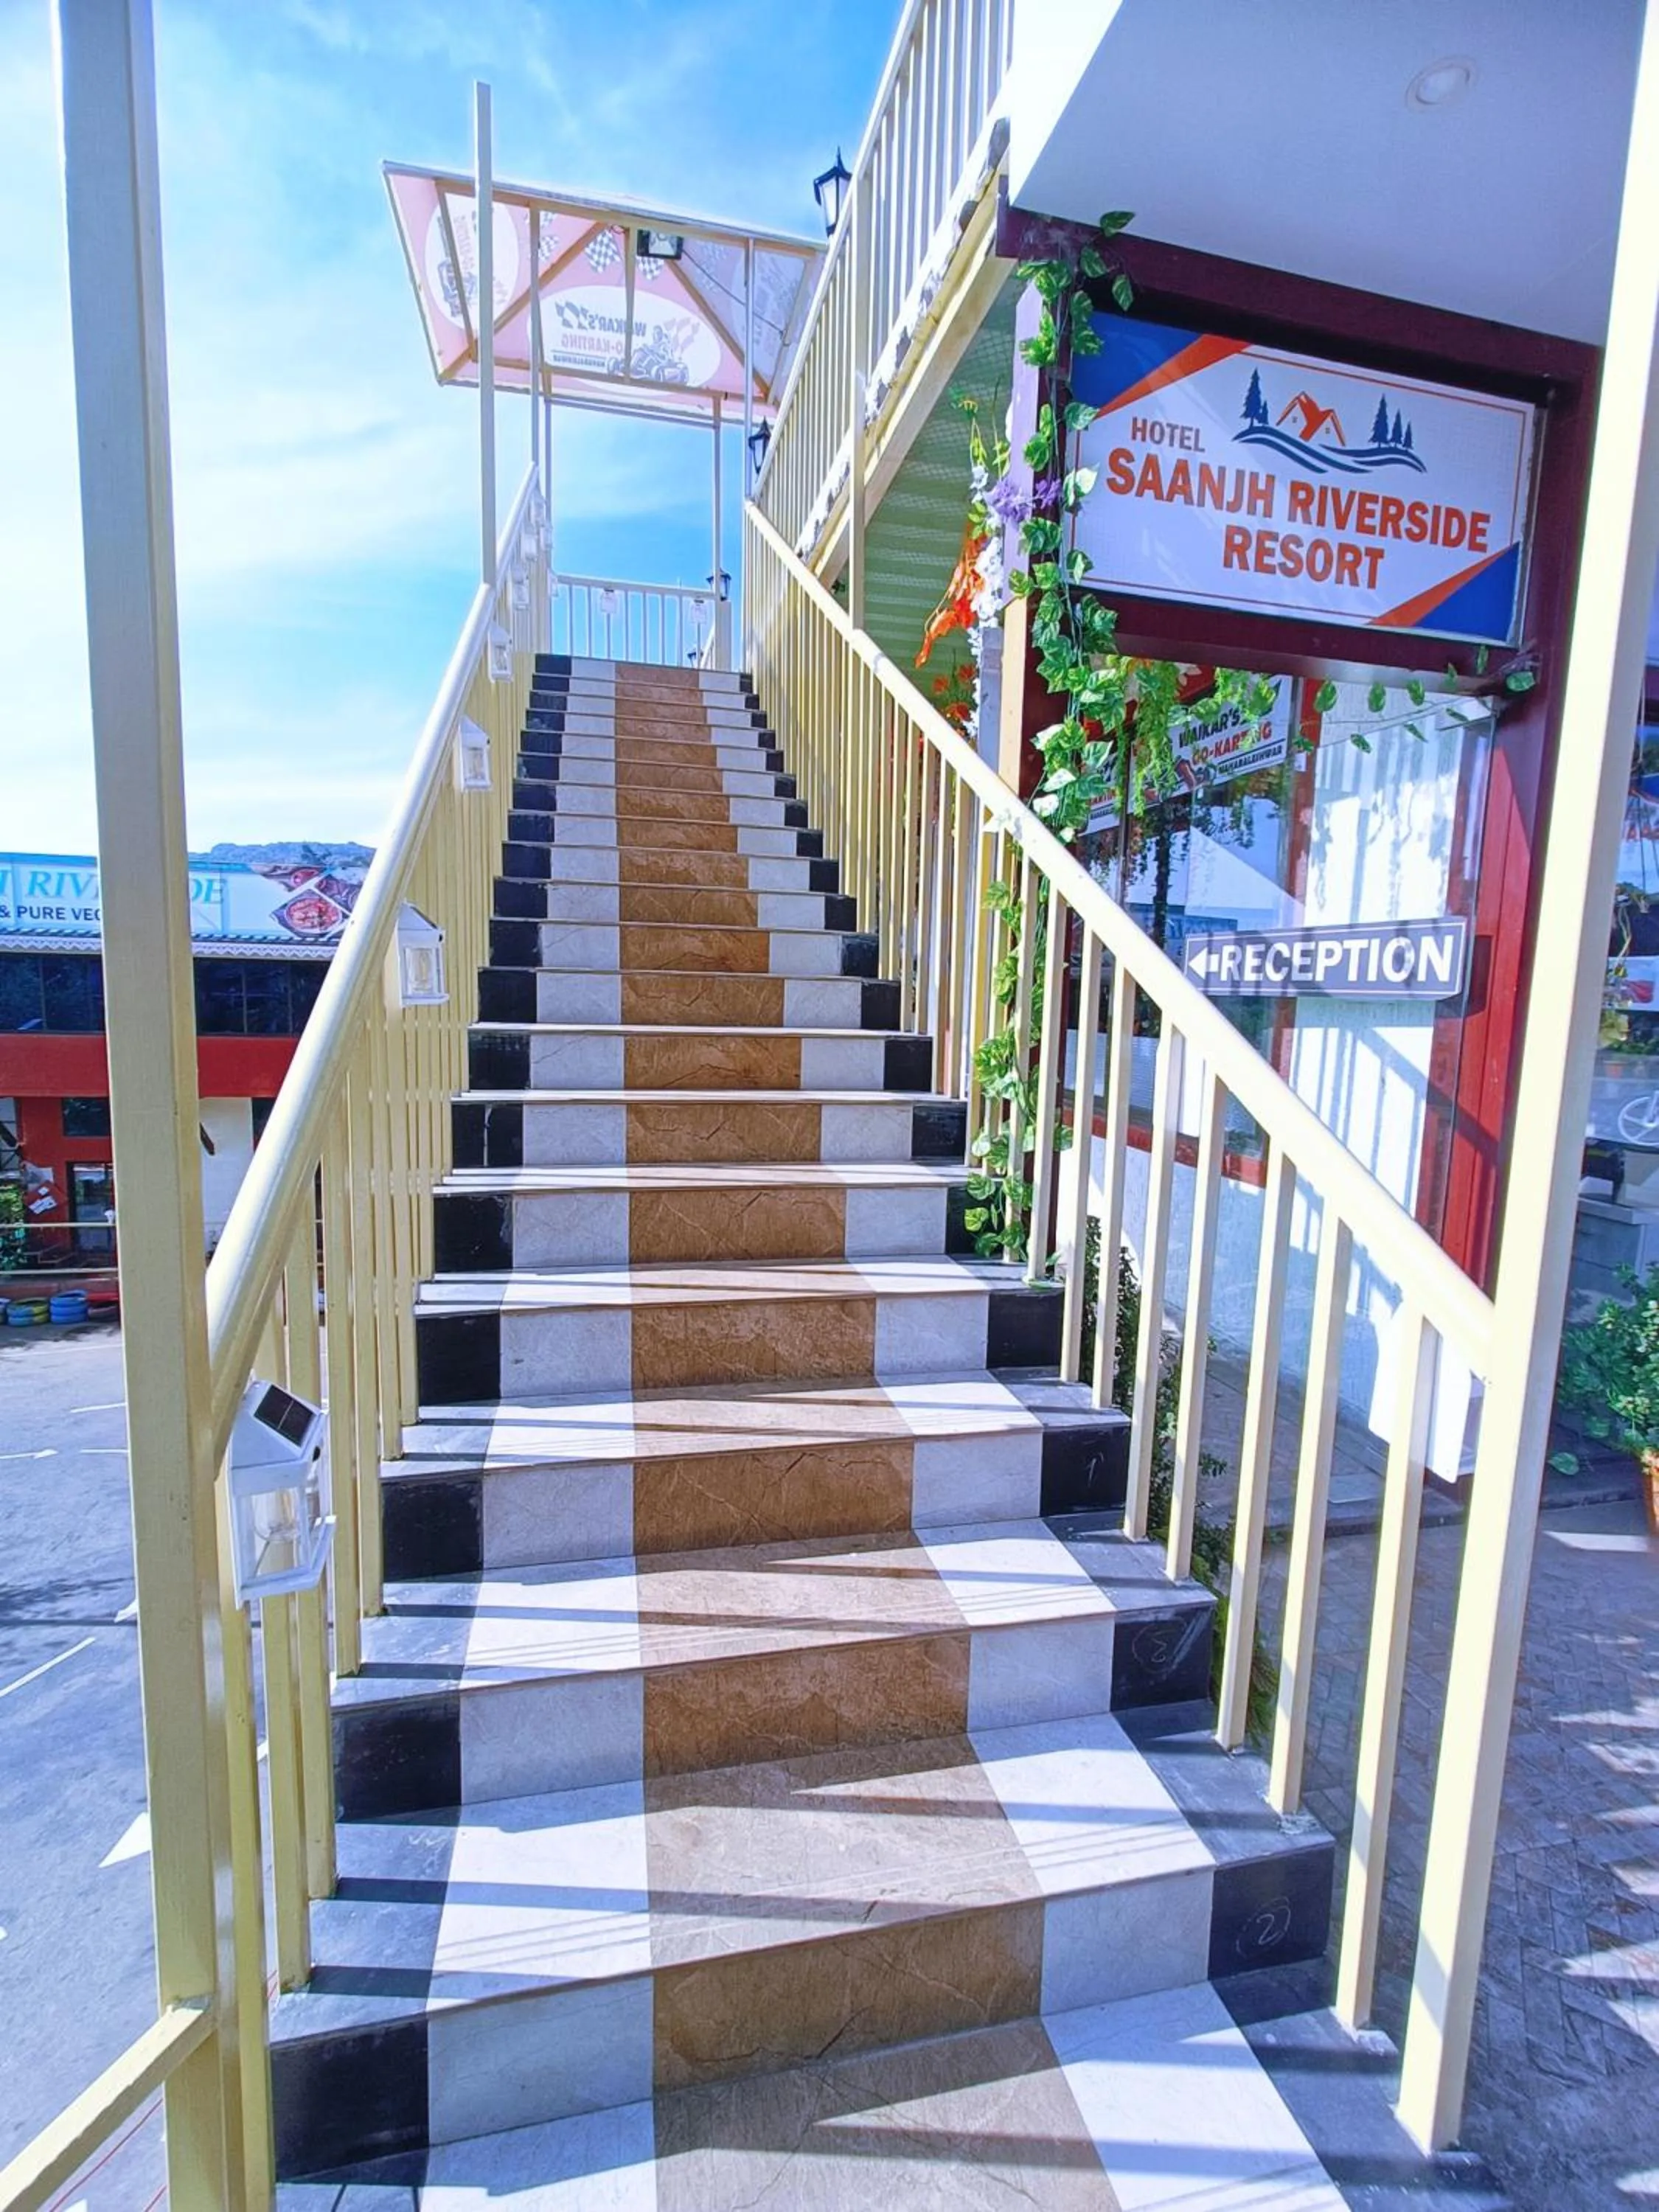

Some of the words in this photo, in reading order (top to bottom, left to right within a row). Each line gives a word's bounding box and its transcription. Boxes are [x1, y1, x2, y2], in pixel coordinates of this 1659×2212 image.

[1131, 417, 1206, 453] HOTEL
[1106, 448, 1275, 518] SAANJH
[1287, 480, 1490, 553] RIVERSIDE
[1222, 524, 1385, 590] RESORT
[17, 905, 66, 920] PURE
[1220, 934, 1455, 983] RECEPTION
